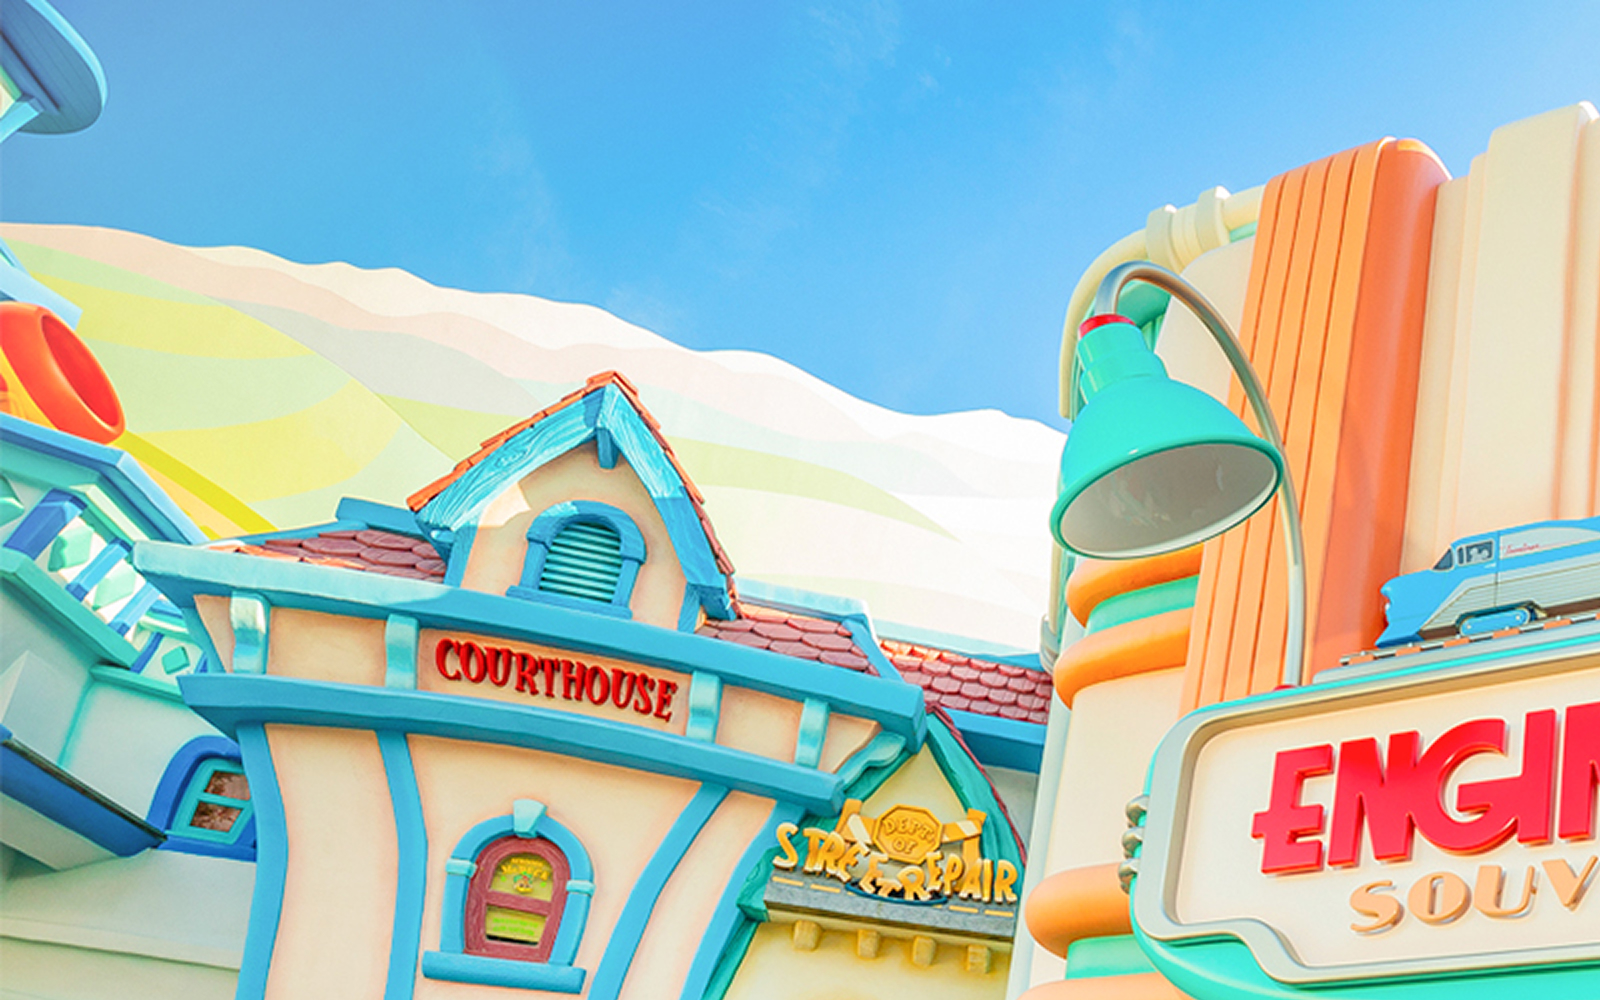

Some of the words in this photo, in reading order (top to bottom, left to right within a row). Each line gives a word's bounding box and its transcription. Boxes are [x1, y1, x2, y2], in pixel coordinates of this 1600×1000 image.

[435, 638, 678, 722] COURTHOUSE
[772, 822, 902, 898] STREET
[897, 850, 1019, 903] REPAIR
